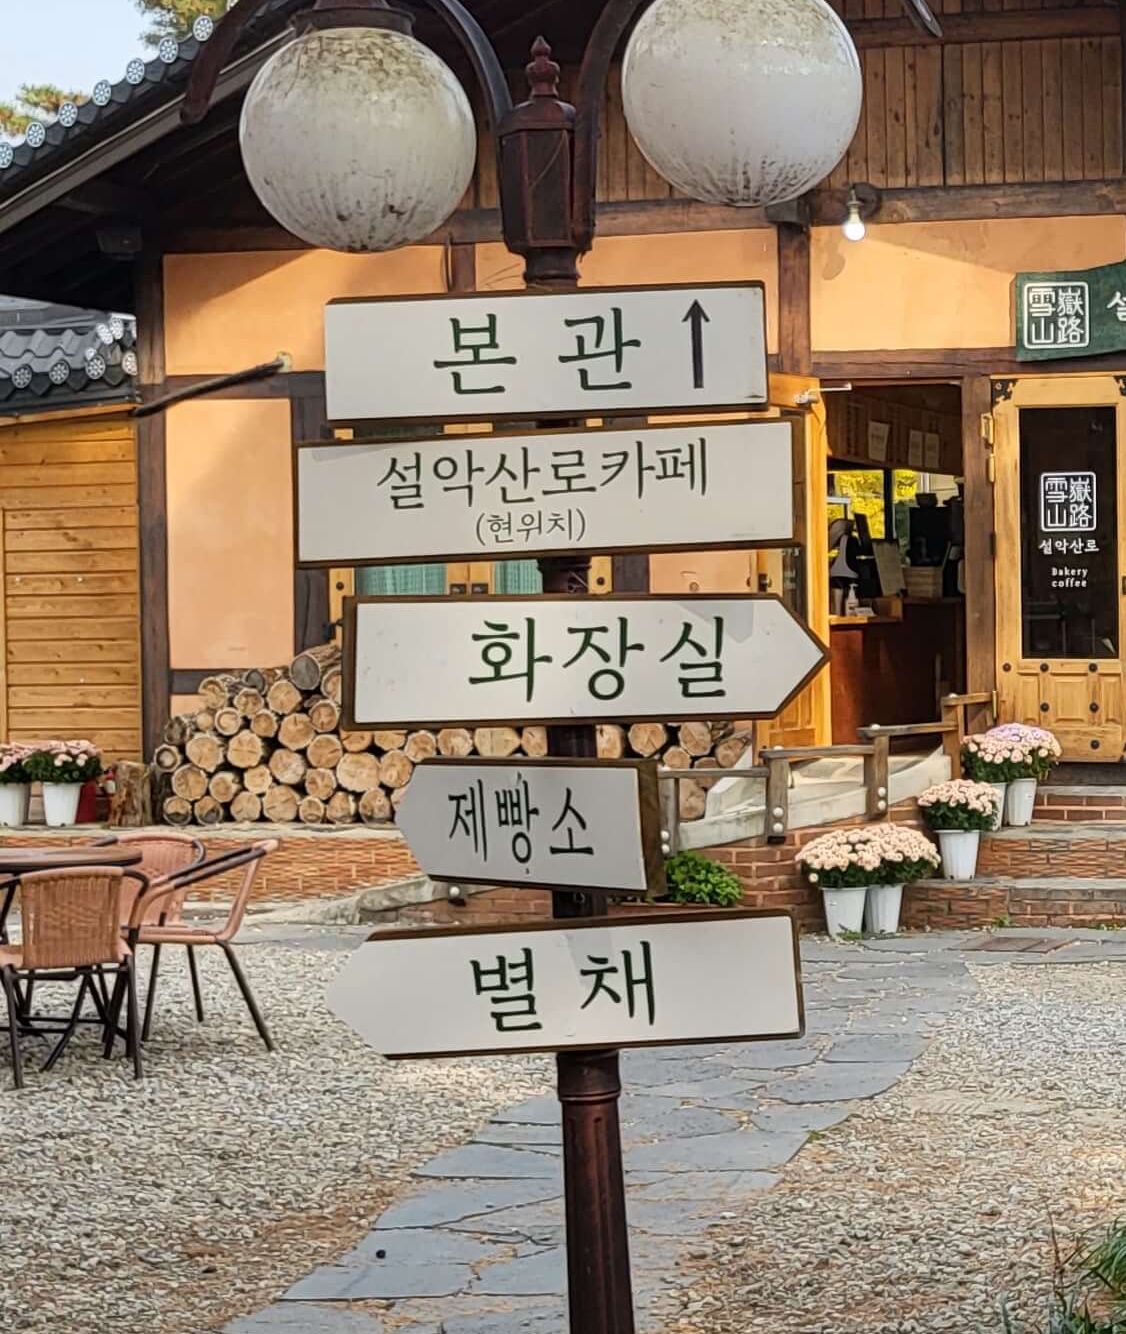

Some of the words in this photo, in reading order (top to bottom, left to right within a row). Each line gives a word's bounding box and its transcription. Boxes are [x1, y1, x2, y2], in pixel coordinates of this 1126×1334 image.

[1031, 317, 1085, 344] 山路
[375, 436, 709, 510] 설악산로카페
[475, 507, 587, 546] (현위치)
[1047, 503, 1093, 528] 山路
[1038, 538, 1100, 555] 설악산로
[1051, 566, 1088, 578] Bakery
[1051, 578, 1087, 588] coffee
[468, 616, 727, 703] 화장실
[447, 779, 595, 864] 제빵소
